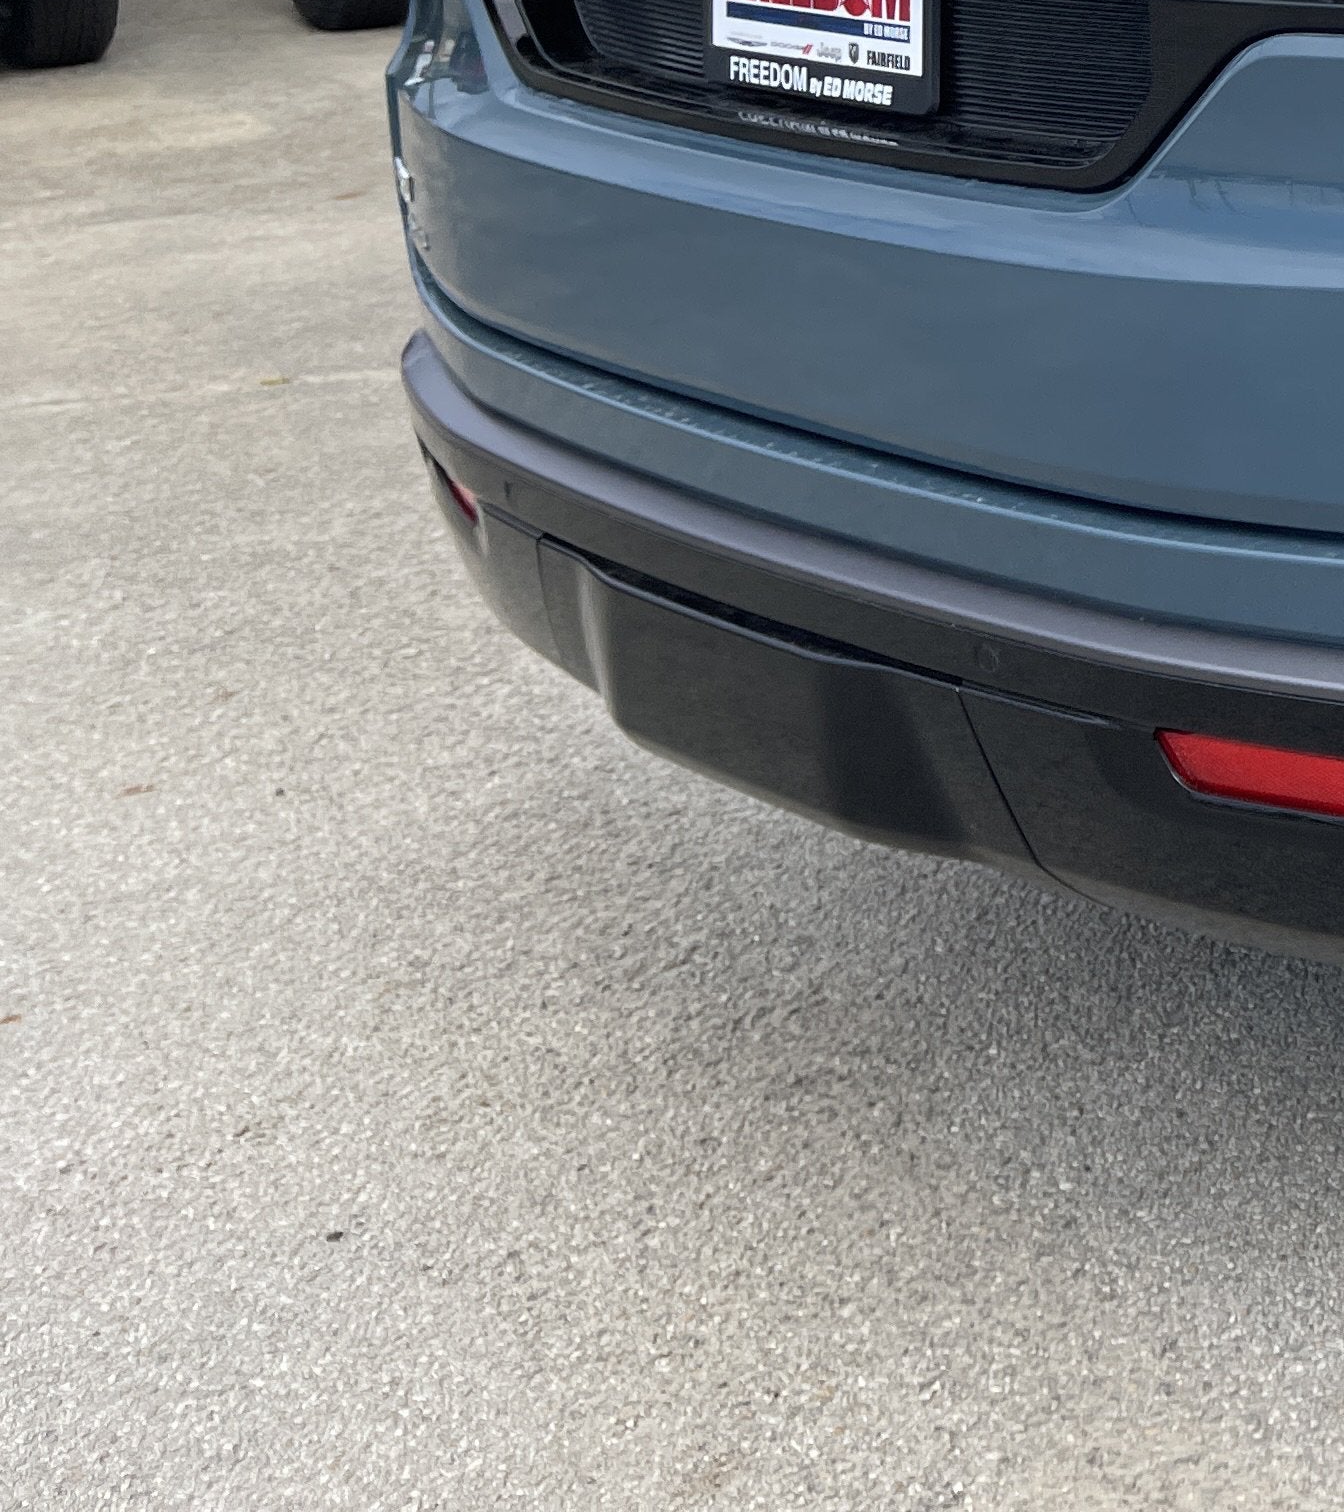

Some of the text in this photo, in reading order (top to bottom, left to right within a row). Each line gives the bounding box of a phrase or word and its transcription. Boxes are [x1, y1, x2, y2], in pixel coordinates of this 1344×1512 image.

[866, 50, 911, 71] FAIRFIELD
[729, 55, 894, 106] FREEDOM by ED MORSE
